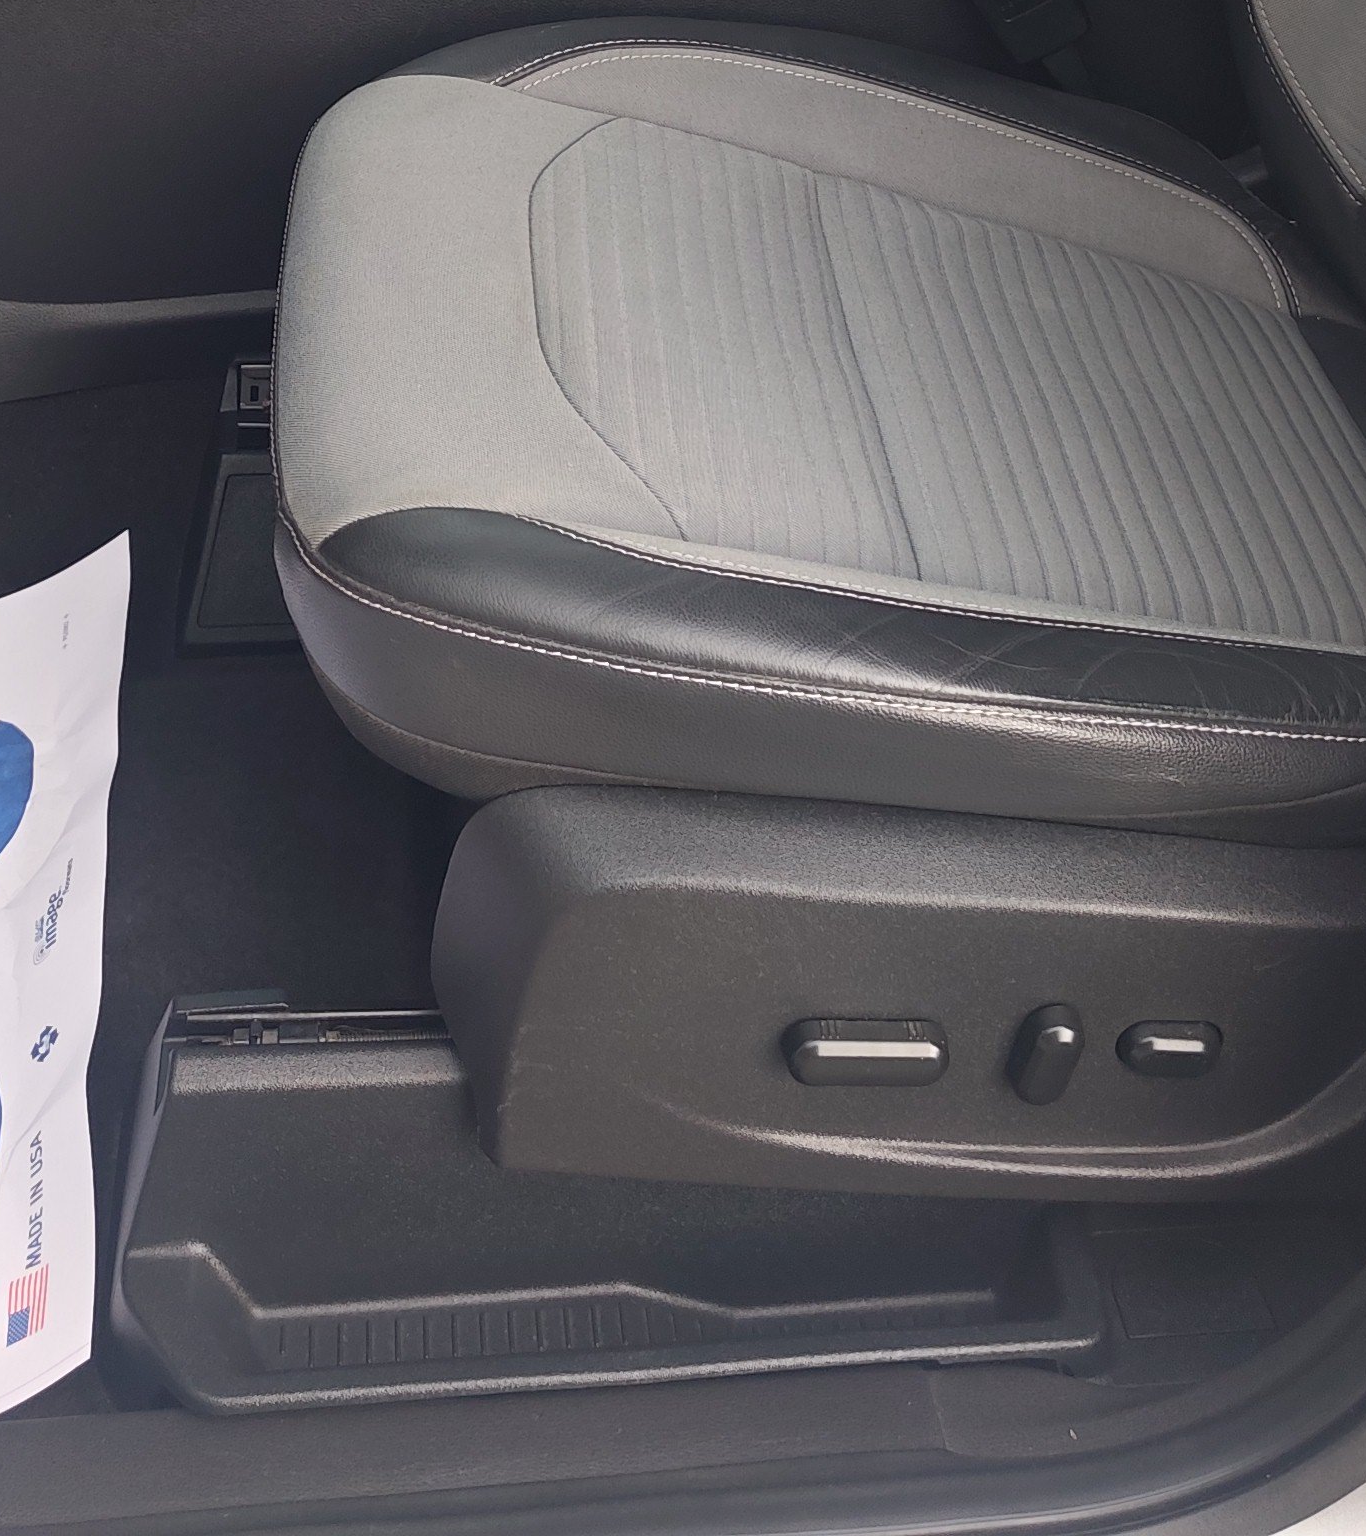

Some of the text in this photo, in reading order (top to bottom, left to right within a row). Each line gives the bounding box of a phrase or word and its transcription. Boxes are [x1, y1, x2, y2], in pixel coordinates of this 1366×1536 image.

[25, 1130, 43, 1270] MADE IN USA
